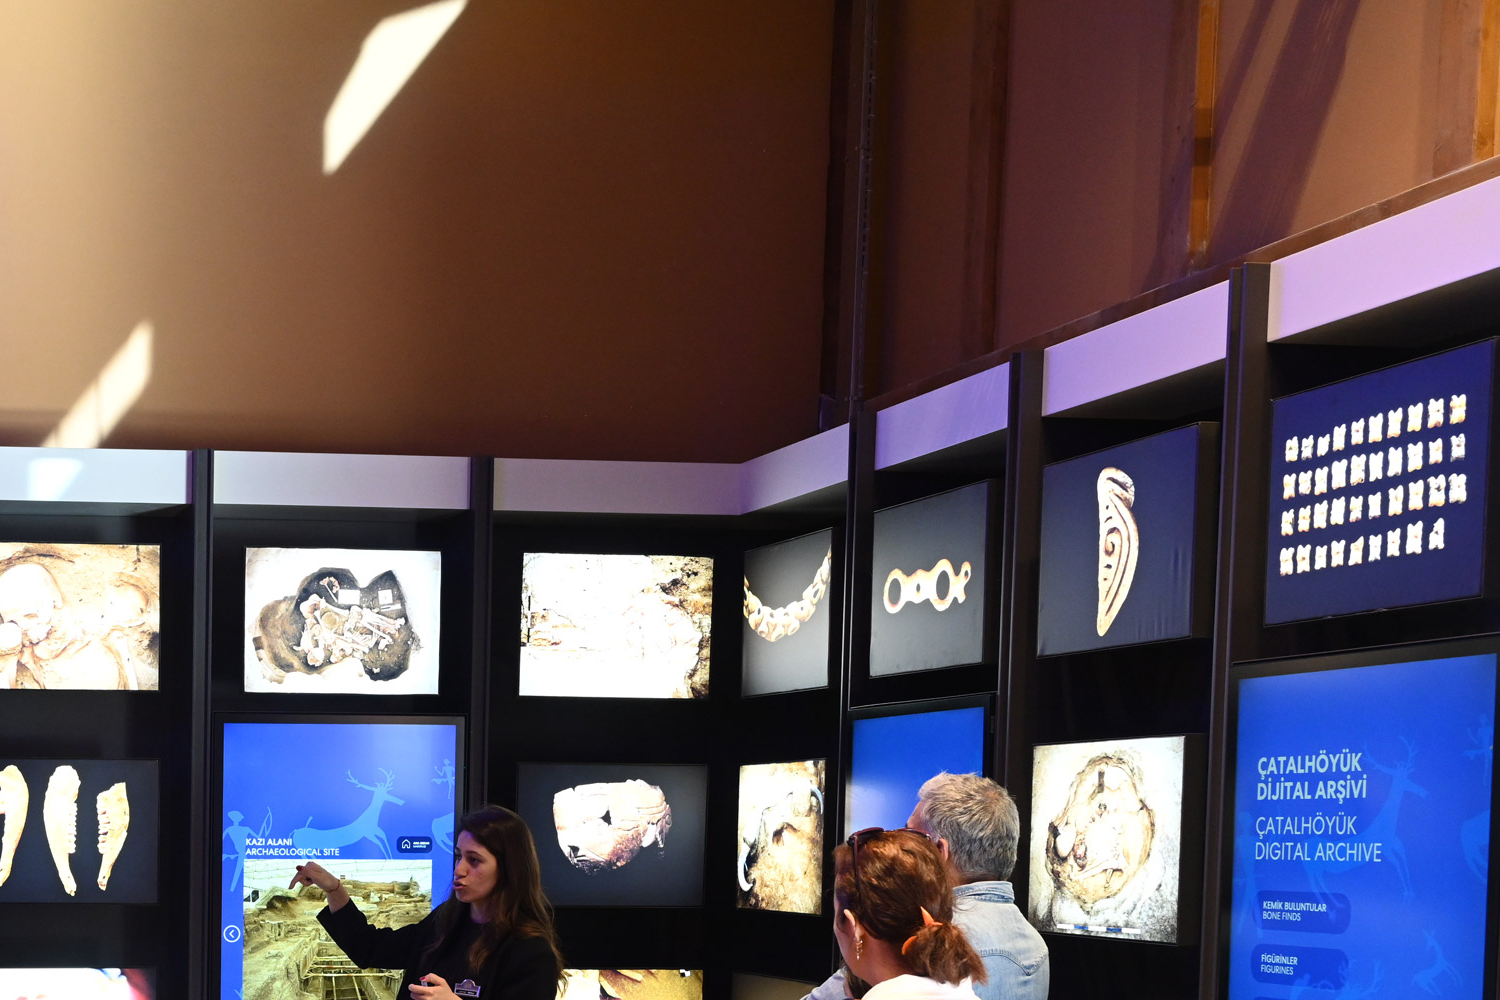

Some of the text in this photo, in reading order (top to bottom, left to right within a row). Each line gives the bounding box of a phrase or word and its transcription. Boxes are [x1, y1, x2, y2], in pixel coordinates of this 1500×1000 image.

[1257, 748, 1363, 781] ÇATALHÖYÜK
[1256, 774, 1368, 804] DİJİTAL ARŞİVİ
[1255, 811, 1358, 840] ÇATALHÖYÜK
[245, 838, 292, 846] KAZI ALANI
[245, 848, 340, 856] ARCHAEOLOGICAL SITE
[1255, 842, 1383, 862] DIGITAL ARCHIVE
[1284, 902, 1327, 912] BULUNTULAR
[1262, 911, 1301, 921] BONE FINDS
[1260, 964, 1294, 975] FIGURINES
